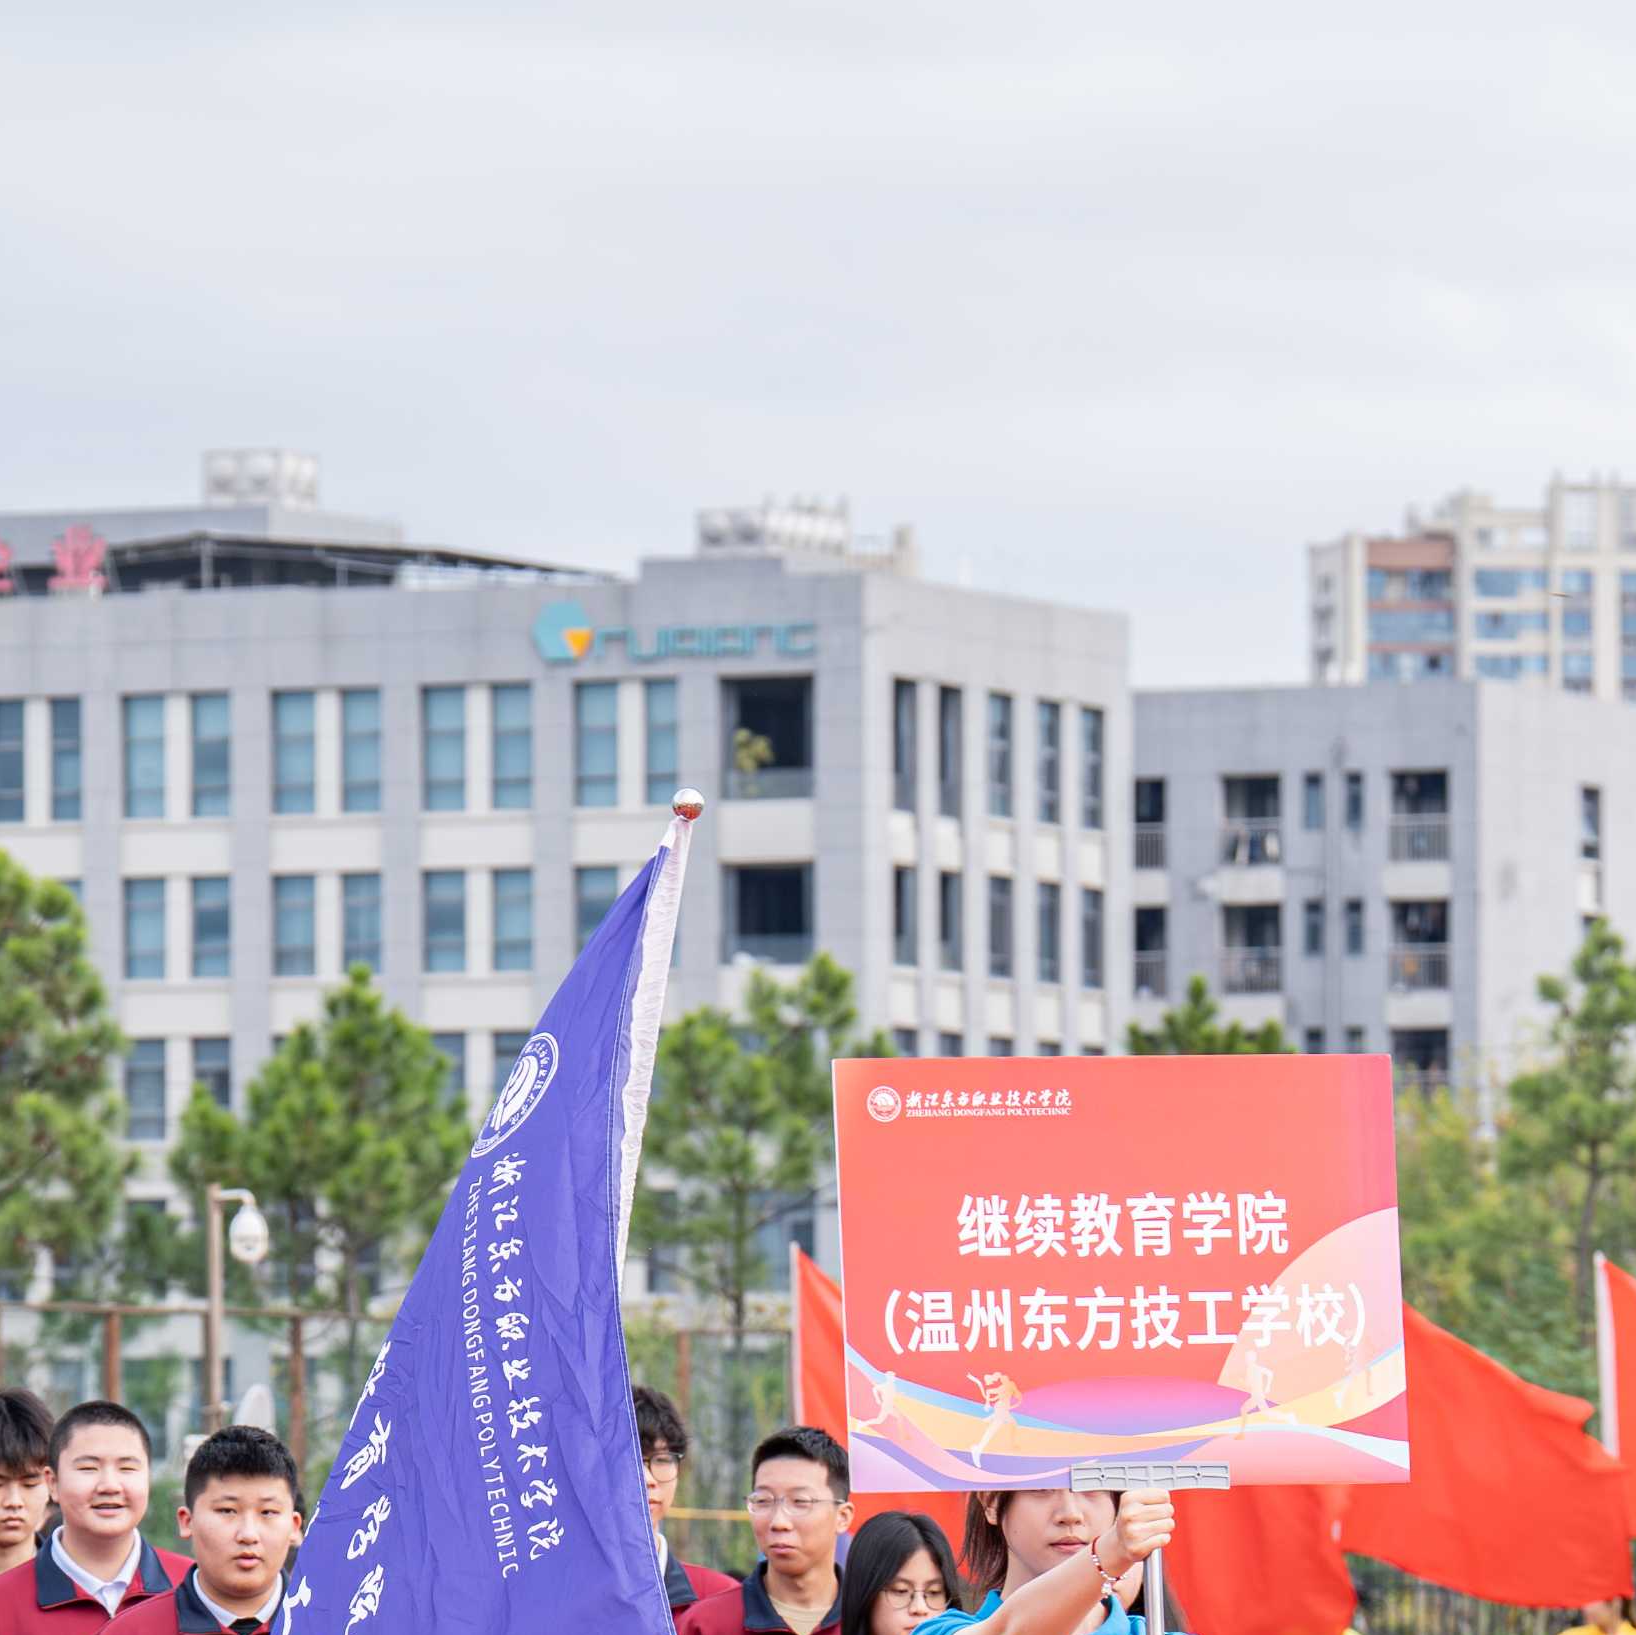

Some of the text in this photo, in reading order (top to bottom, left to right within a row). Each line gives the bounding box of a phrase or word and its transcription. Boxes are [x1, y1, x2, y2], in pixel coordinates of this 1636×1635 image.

[905, 1087, 1073, 1109] 浙江东方职业技术学院
[905, 1106, 1072, 1118] ZHEJIANG DONGFANG POLYTECHNIC
[460, 1175, 483, 1288] ZHEJIANG
[956, 1190, 1290, 1258] 继续教育学院
[882, 1282, 1368, 1356] (温州东方技工学校)
[487, 1152, 564, 1561] 浙江东方职业技术学院
